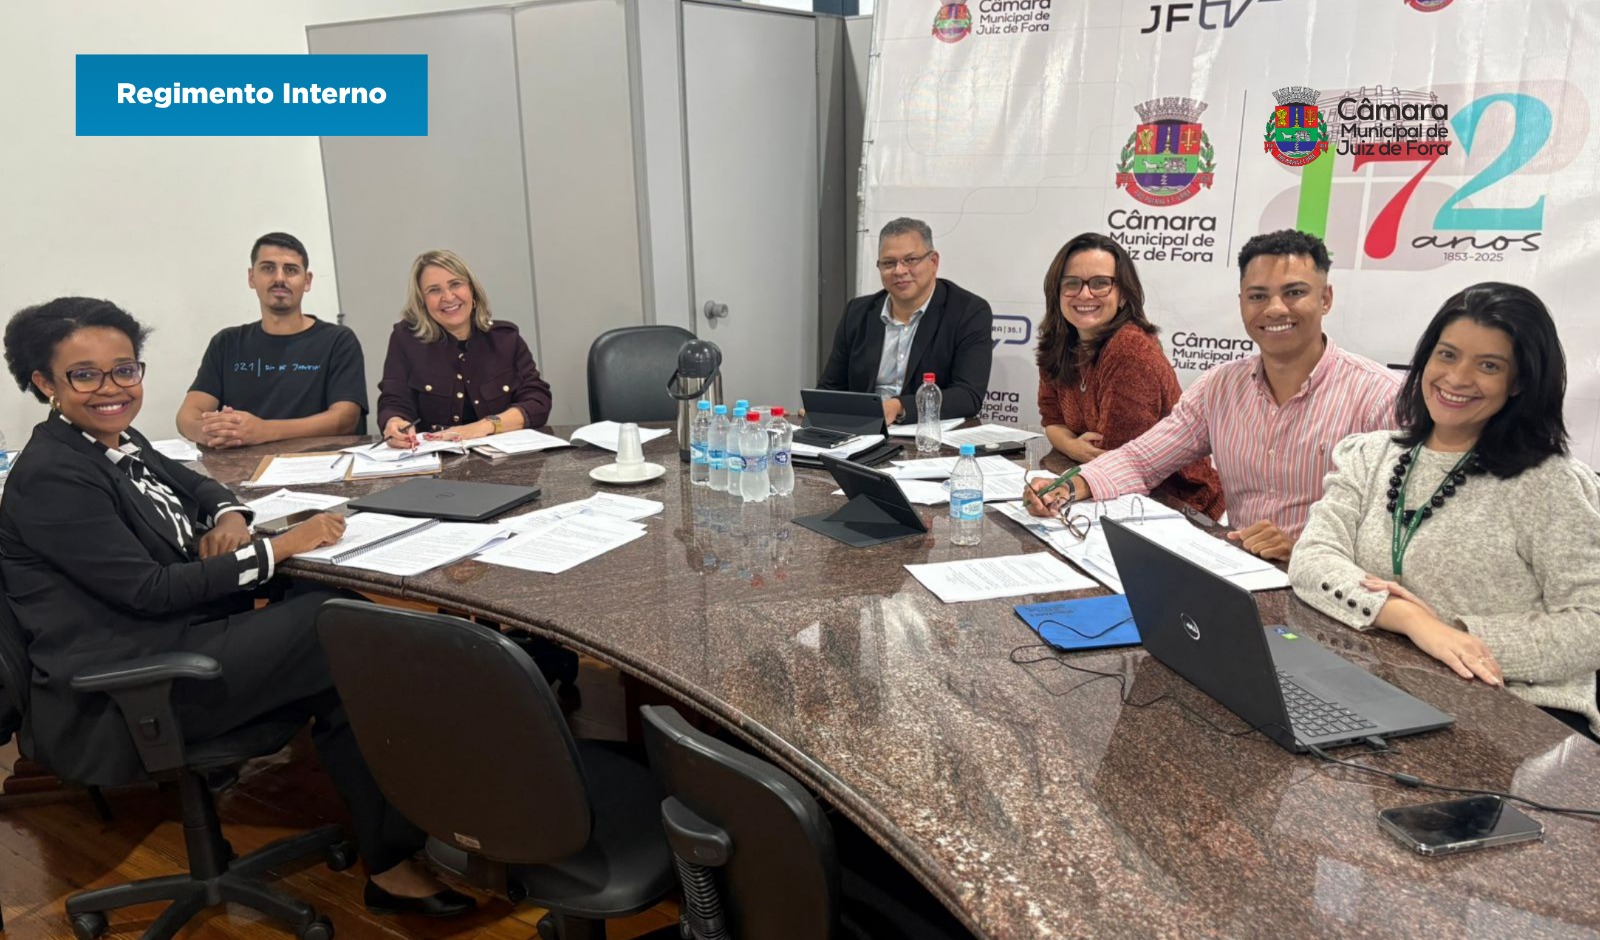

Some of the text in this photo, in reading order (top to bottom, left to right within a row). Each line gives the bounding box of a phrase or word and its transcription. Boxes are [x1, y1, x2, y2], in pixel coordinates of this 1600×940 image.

[979, 0, 1051, 13] Câmara
[980, 11, 1050, 24] Municipal de
[976, 22, 1049, 35] Juiz de Fora
[1107, 209, 1217, 231] Câmara
[1109, 231, 1215, 249] Municipal de
[1411, 232, 1542, 251] anos
[1143, 247, 1166, 261] de
[1171, 248, 1213, 262] Fora
[1443, 252, 1504, 262] 1853-2025
[1172, 331, 1253, 351] Câmara
[1172, 348, 1233, 363] Municipal
[1172, 358, 1197, 370] Juiz
[986, 390, 1020, 403] ara
[1005, 403, 1019, 413] de
[991, 411, 1018, 423] Fora
